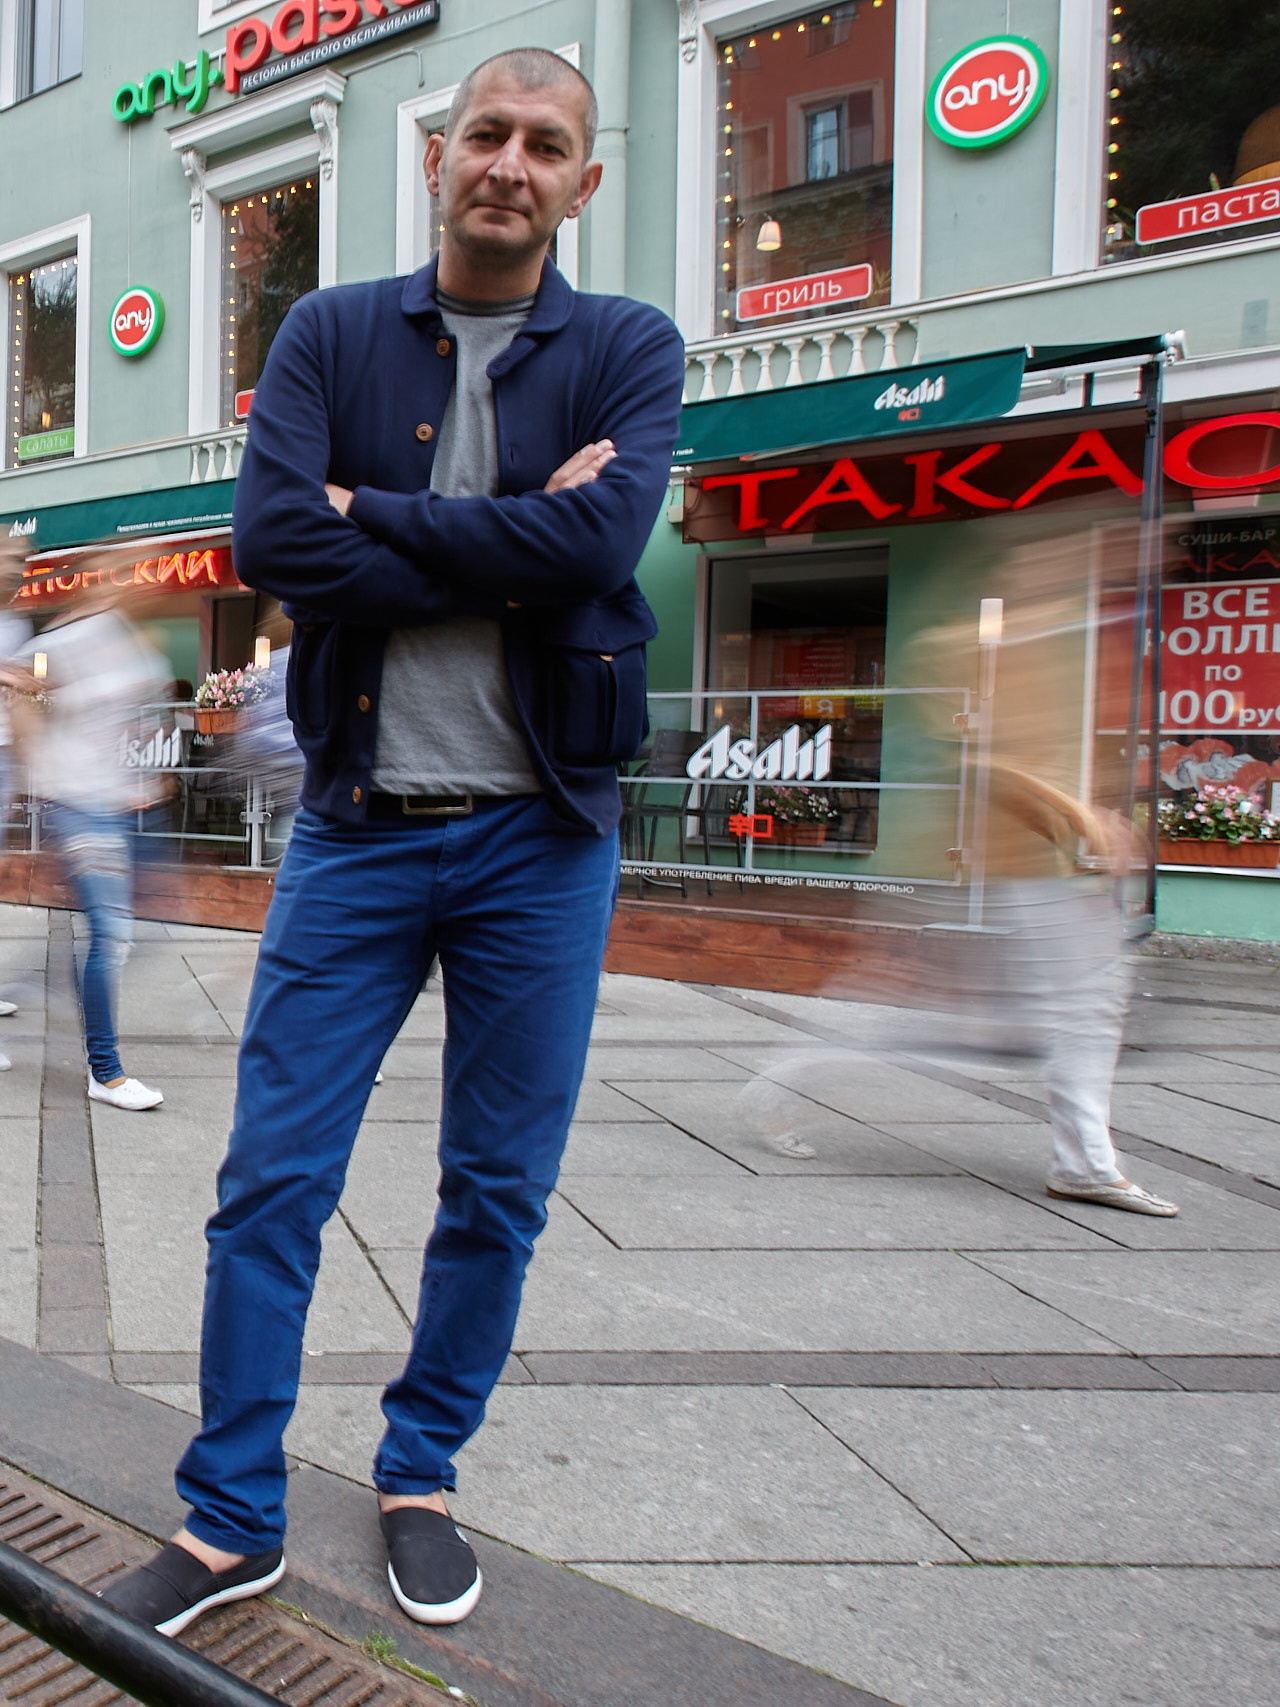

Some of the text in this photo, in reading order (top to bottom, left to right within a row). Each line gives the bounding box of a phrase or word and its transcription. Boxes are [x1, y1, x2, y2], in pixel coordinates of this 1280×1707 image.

[225, 0, 424, 94] pas
[242, 5, 431, 88] РЕСТОРАН БЫСТРОГО ОБСЛУЖИВАНИЯ
[1178, 189, 1280, 229] паста
[763, 279, 842, 312] гриль
[873, 375, 945, 411] Asahi
[26, 435, 68, 453] салаты
[1178, 529, 1277, 546] СУШИ-БАР
[1183, 587, 1270, 620] ВСЕ
[686, 723, 832, 781] Asahi
[620, 866, 915, 894] МЕРНОЕ УПОТРЕБЛЕНИЕ ПИВА ВРЕДИТ ВАШЕМУ ЗДОРОВЬЮ
